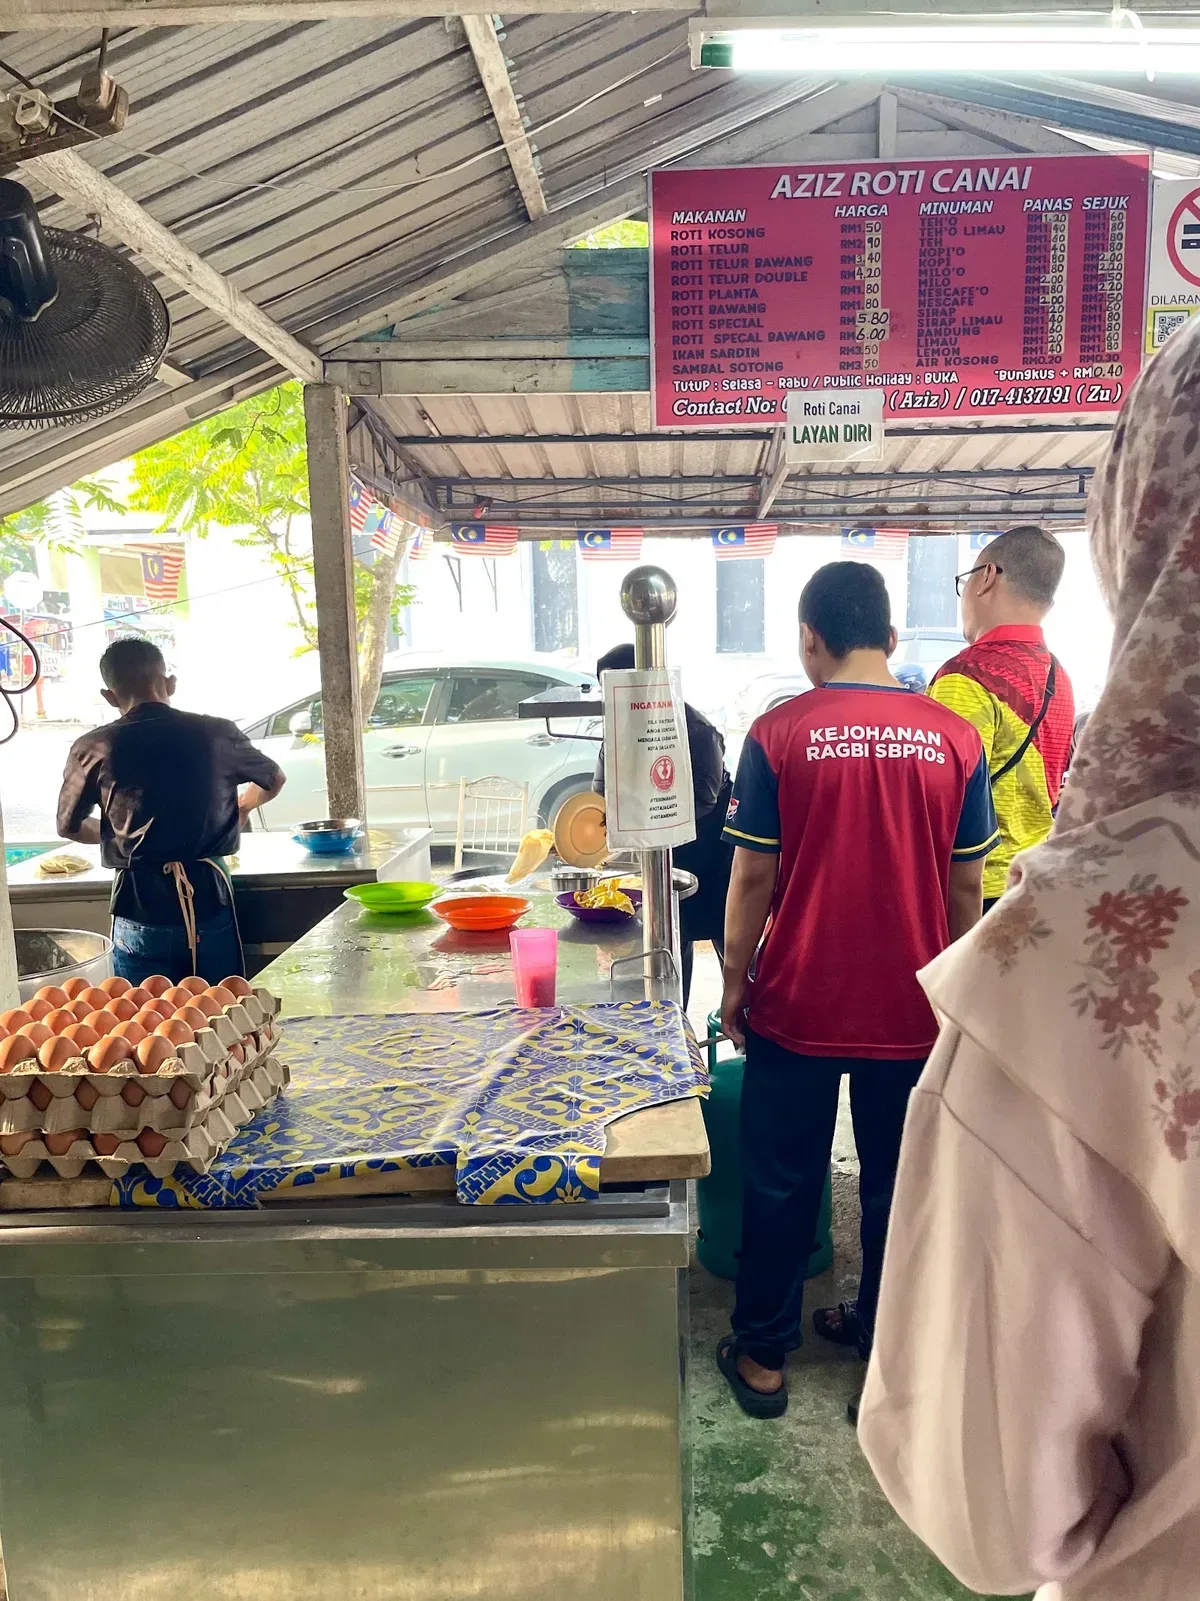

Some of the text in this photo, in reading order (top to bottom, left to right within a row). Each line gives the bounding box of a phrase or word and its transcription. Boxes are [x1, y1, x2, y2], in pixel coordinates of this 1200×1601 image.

[771, 166, 1032, 198] AZIZ ROTI CANAI
[920, 196, 1129, 215] MINUMAN PANAS SEJUK
[673, 204, 888, 224] MAKANAN HARGA
[671, 230, 702, 240] ROTI
[708, 228, 765, 239] KOSONG
[964, 225, 1005, 235] LIMAU
[920, 238, 942, 247] TEH
[671, 246, 703, 255] ROTI
[708, 244, 748, 254] TELUR
[671, 261, 703, 271] ROTI
[708, 259, 749, 269] TELUR
[755, 256, 813, 267] BAWANG
[919, 258, 950, 267] KOPI
[672, 276, 703, 286] ROTI
[709, 274, 749, 284] TELUR
[755, 272, 808, 283] DOUBLE
[919, 278, 950, 287] MILO
[672, 291, 703, 300] ROTI
[709, 289, 758, 299] PLANTA
[918, 297, 974, 307] NESCAFE
[672, 306, 703, 316] ROTI
[709, 303, 766, 314] BAWANG
[918, 308, 956, 317] SIRAP
[672, 320, 703, 330] ROTI
[709, 318, 764, 329] SPECIAL
[918, 318, 956, 327] SIRAP
[962, 316, 1002, 326] LIMAU
[672, 335, 703, 345] ROTI
[768, 330, 825, 341] BAWANG
[917, 327, 980, 337] BANDUNG
[917, 338, 957, 347] LIMAU
[673, 350, 704, 360] IKAN
[711, 348, 759, 358] SARDIN
[917, 348, 960, 357] LEMON
[916, 354, 1119, 367] AIR KOSONG RM0.20 RM0.30
[673, 364, 724, 374] SAMBAL
[730, 362, 783, 372] SOTONG
[723, 379, 761, 390] Selasa
[866, 373, 911, 385] Holiday
[925, 372, 958, 383] BUKA
[673, 399, 741, 415] Contact
[746, 397, 776, 413] No:
[971, 386, 1070, 405] 017-4137191
[804, 401, 860, 415] Roti Canai
[793, 424, 871, 444] LAYAN DIRI
[810, 726, 940, 746] KEJOHANAN
[806, 743, 945, 764] RAGBI SBP10s
